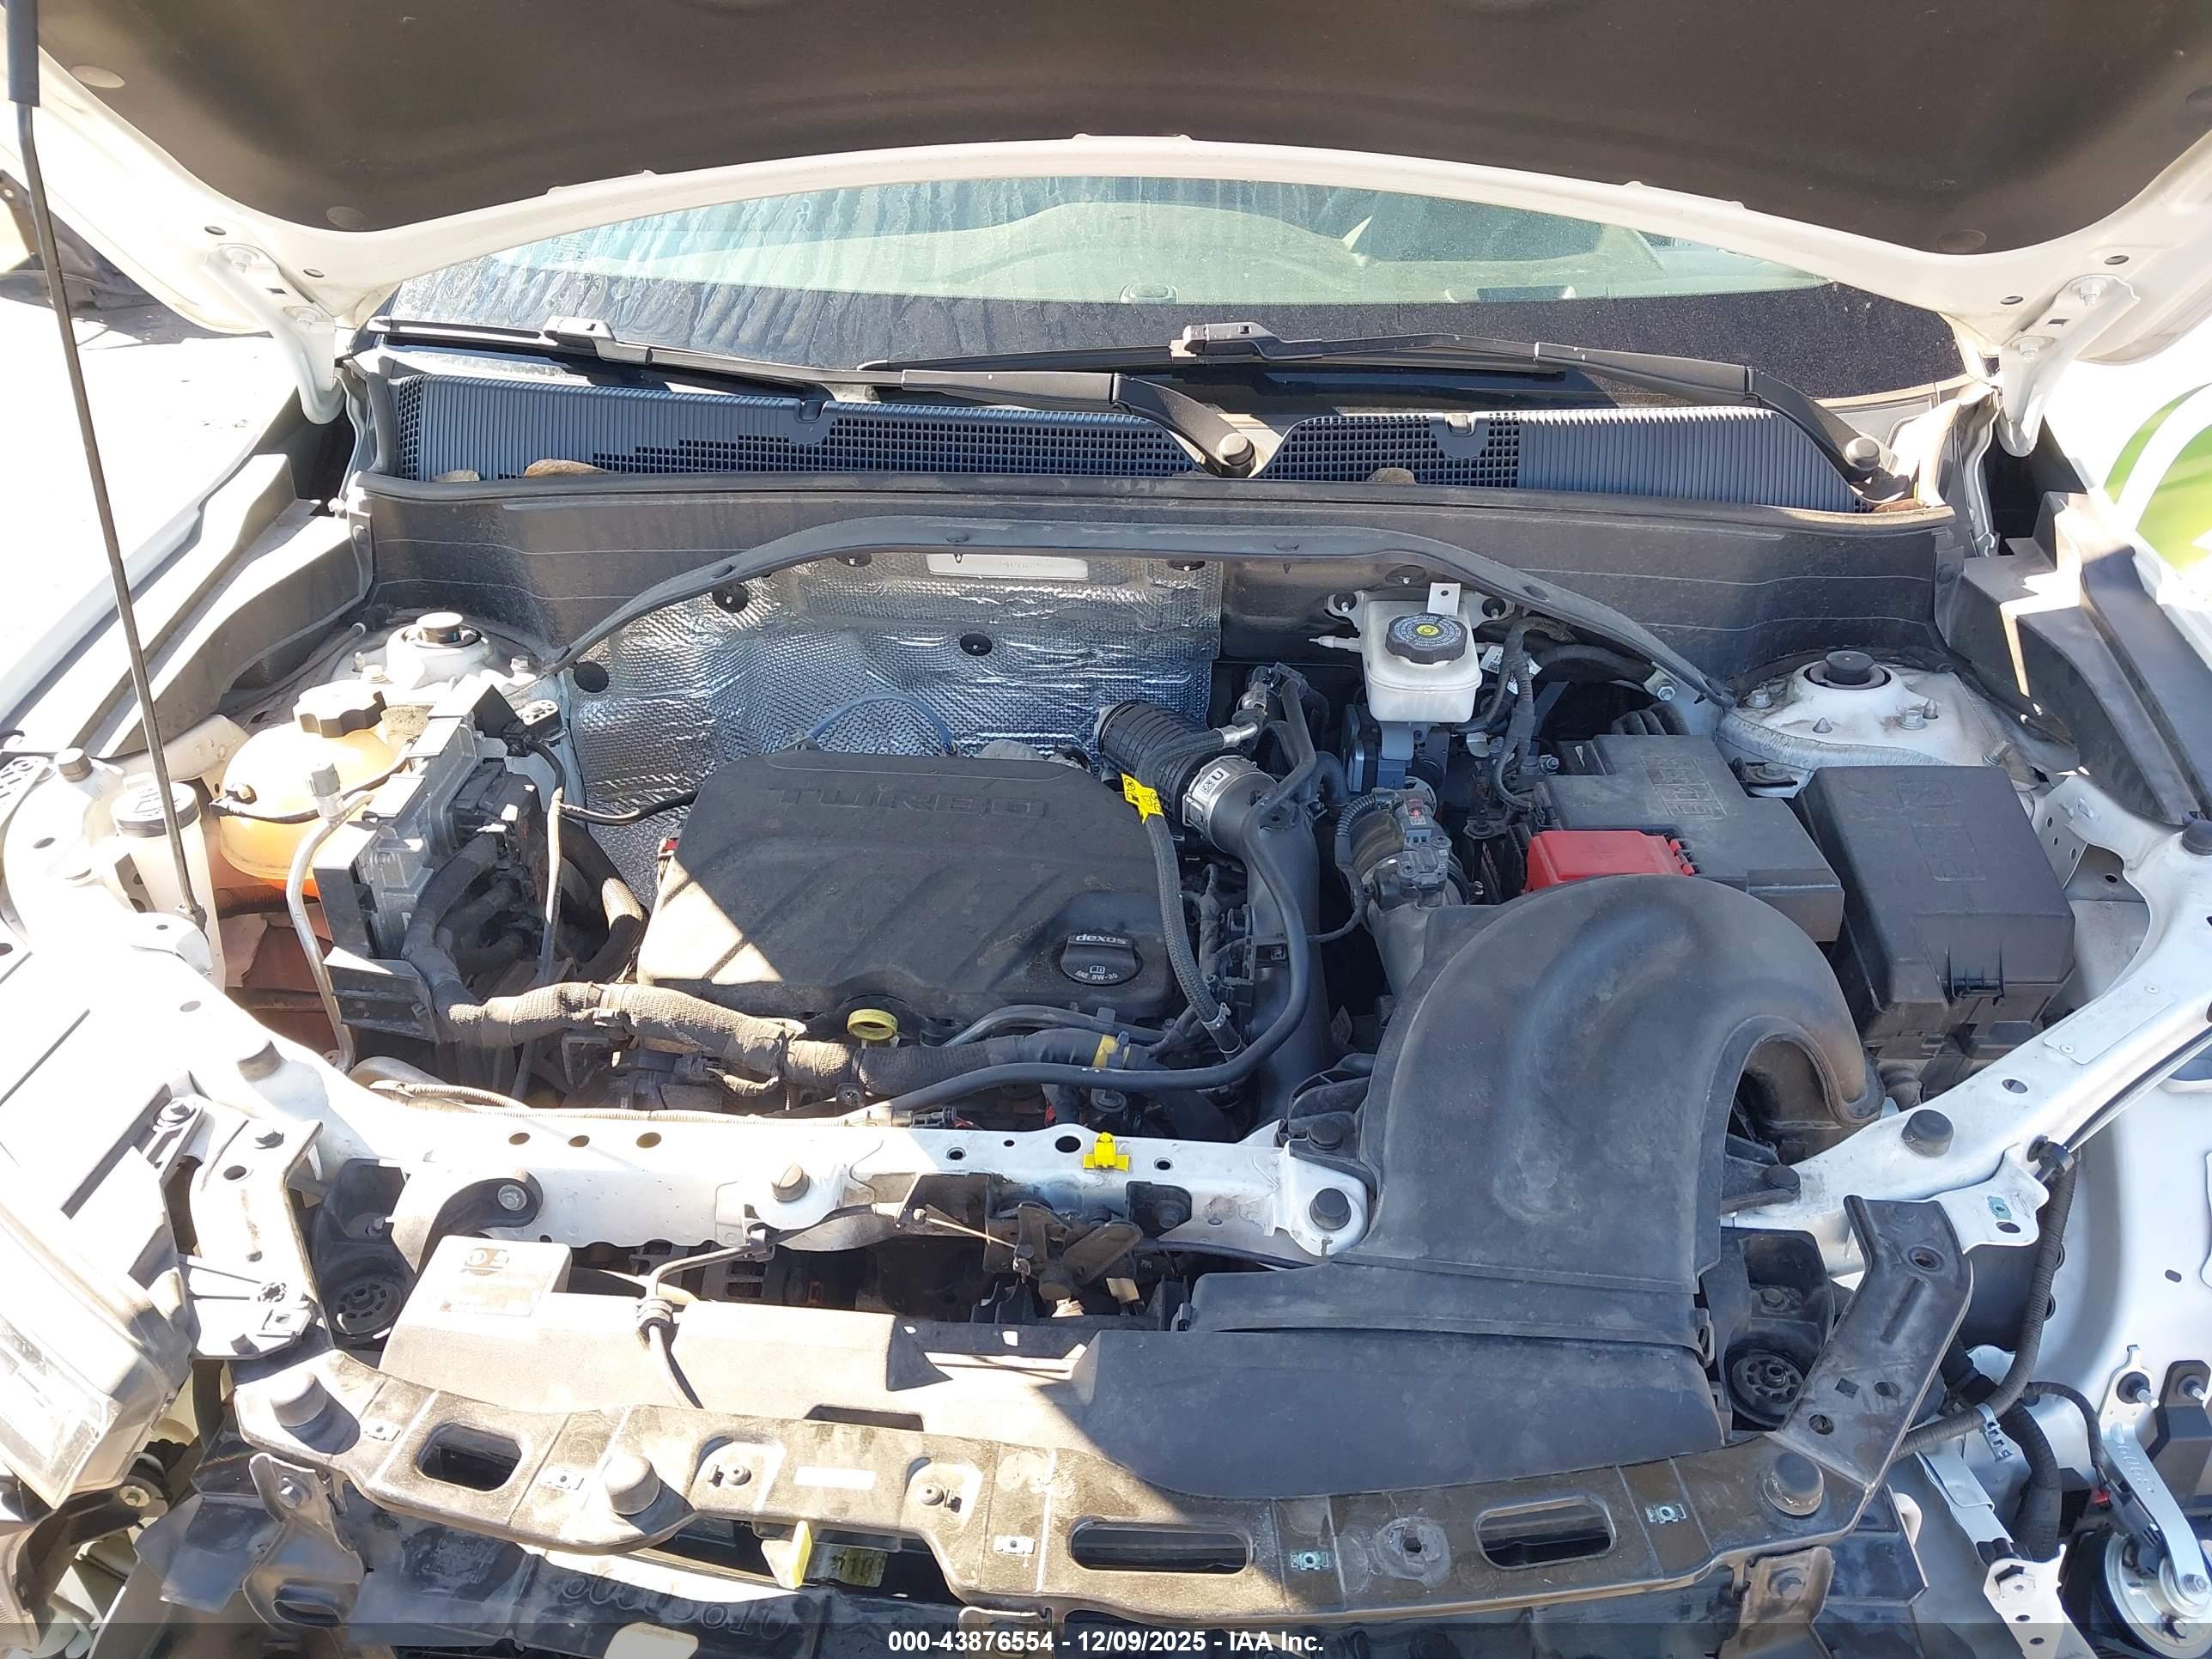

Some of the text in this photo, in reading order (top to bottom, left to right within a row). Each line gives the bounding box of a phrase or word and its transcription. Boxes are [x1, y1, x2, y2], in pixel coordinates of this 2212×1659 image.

[1075, 933, 1129, 945] dexos
[1074, 969, 1119, 981] SAE 5W-30
